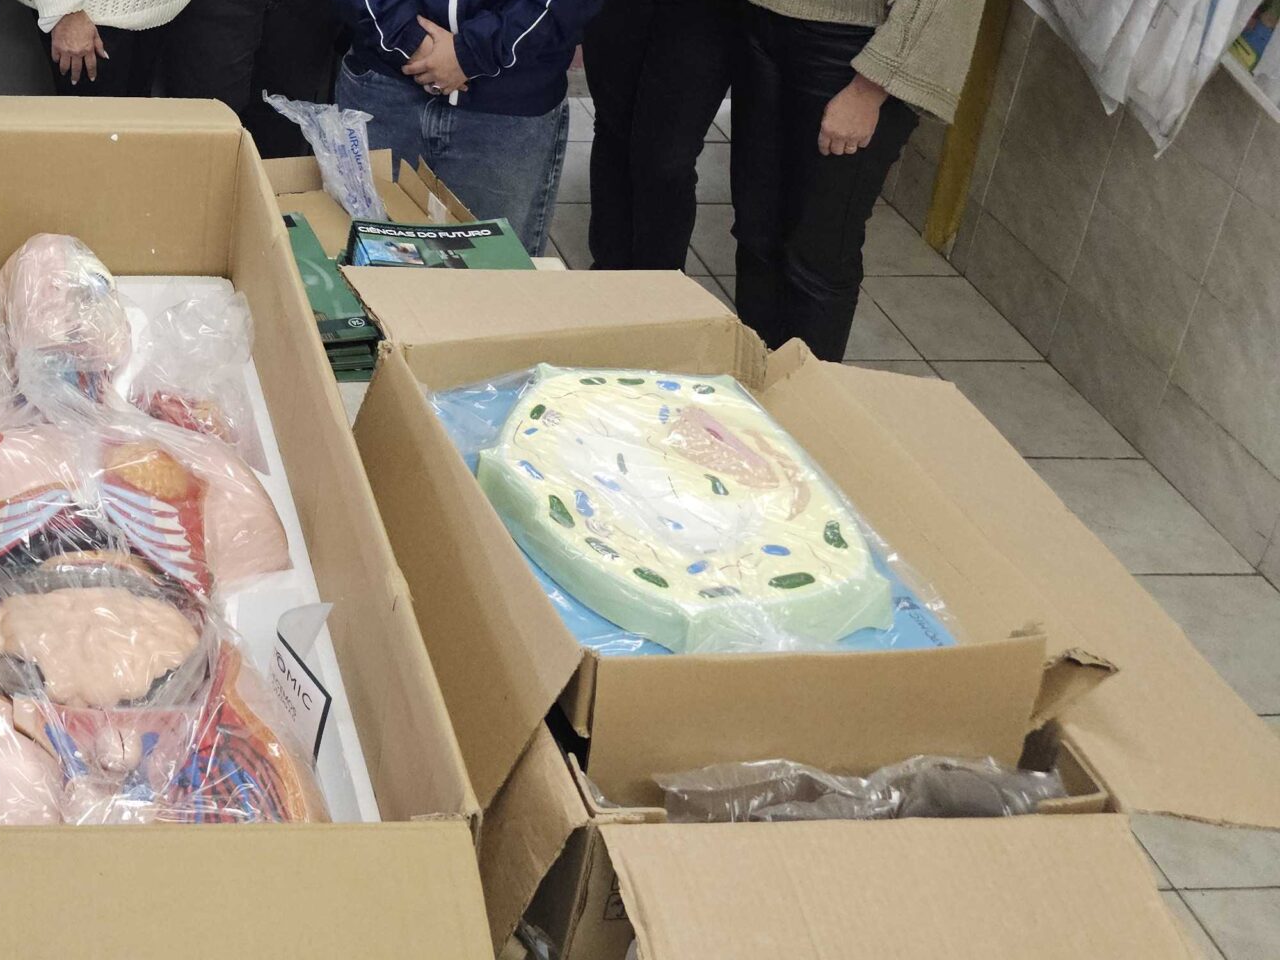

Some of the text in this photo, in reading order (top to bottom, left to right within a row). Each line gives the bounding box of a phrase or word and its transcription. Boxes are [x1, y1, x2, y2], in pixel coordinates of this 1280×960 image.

[358, 226, 417, 238] CIÊNCIAS
[417, 231, 437, 239] DO
[438, 229, 492, 239] FUTURO
